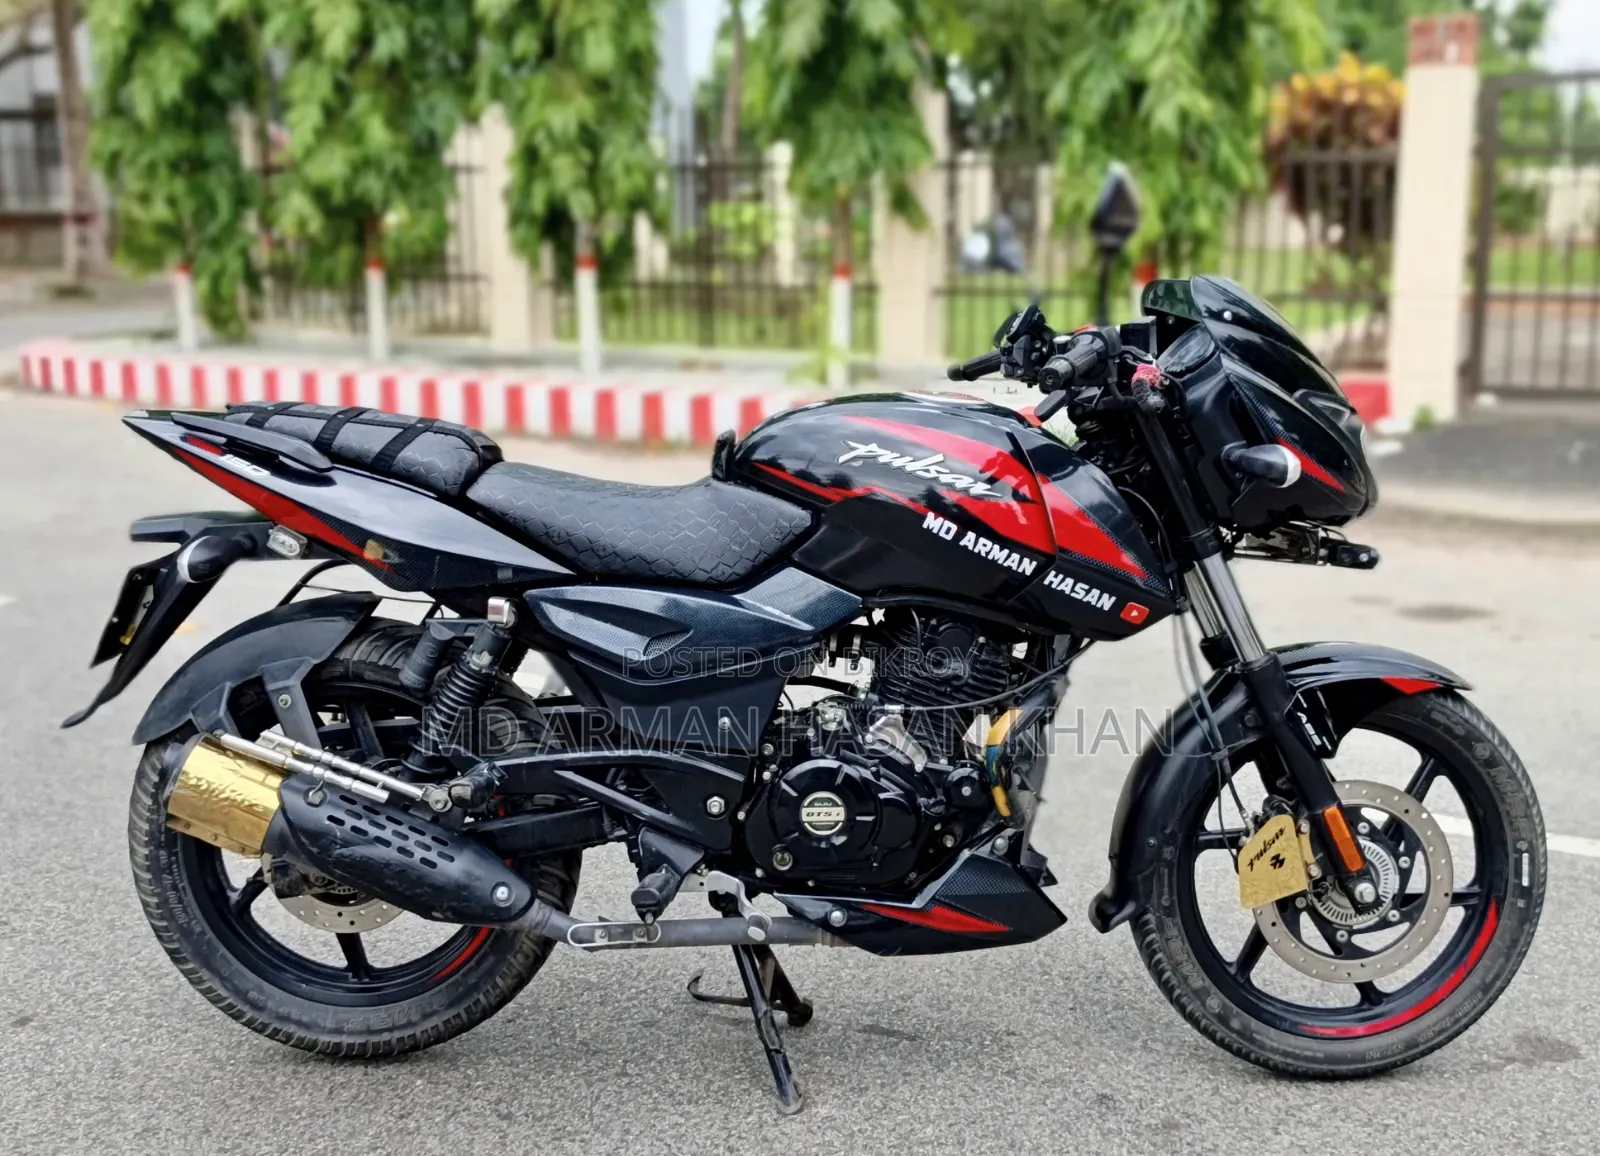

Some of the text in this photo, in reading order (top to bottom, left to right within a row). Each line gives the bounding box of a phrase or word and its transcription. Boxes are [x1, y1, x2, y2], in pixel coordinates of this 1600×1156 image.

[922, 512, 1037, 576] MD ARMAN
[1043, 570, 1117, 612] HASAN
